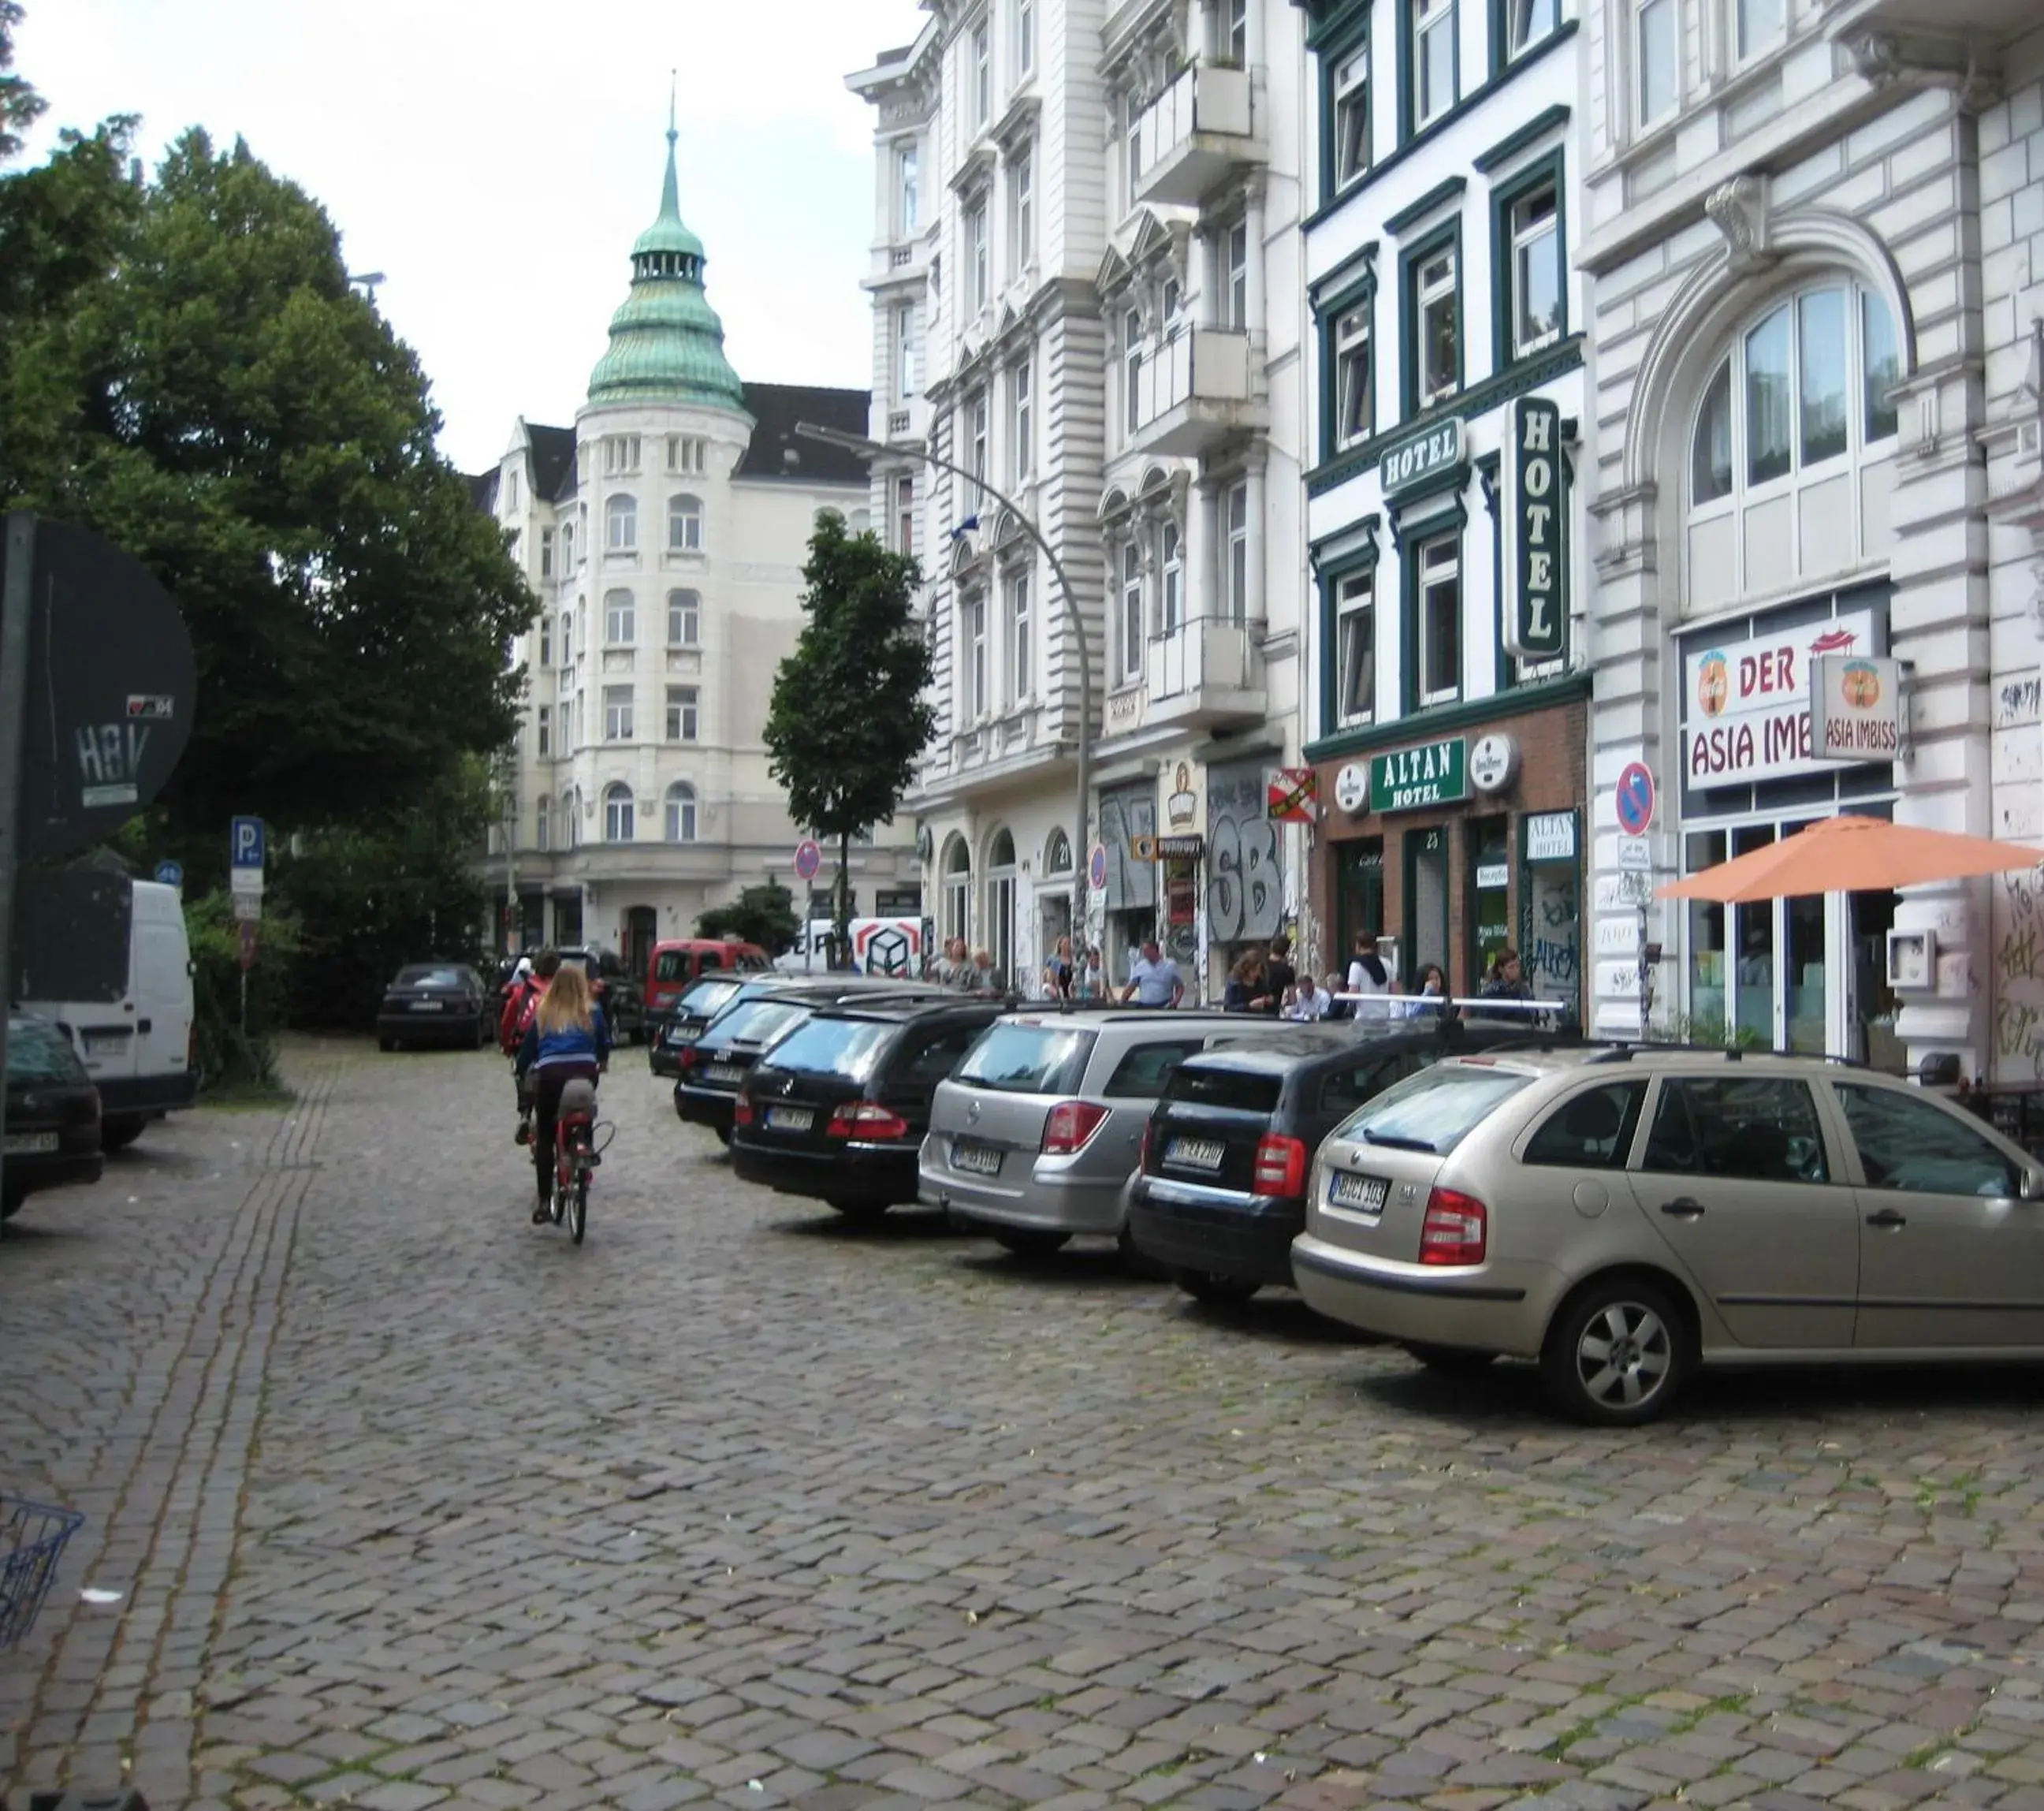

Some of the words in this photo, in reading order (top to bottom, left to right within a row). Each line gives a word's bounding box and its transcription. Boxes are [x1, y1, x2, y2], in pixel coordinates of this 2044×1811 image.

[1386, 428, 1455, 486] HOTEL
[1523, 410, 1551, 639] HOTEL
[1740, 646, 1796, 699] DER
[1692, 721, 1755, 776] ASIA
[1763, 711, 1811, 764] IMB
[1826, 718, 1853, 747] ASIA
[1856, 718, 1897, 751] IMBISS
[1383, 743, 1450, 788] ALTAN
[1392, 783, 1441, 807] HOTEL
[238, 823, 257, 862] P
[1059, 842, 1069, 866] 21
